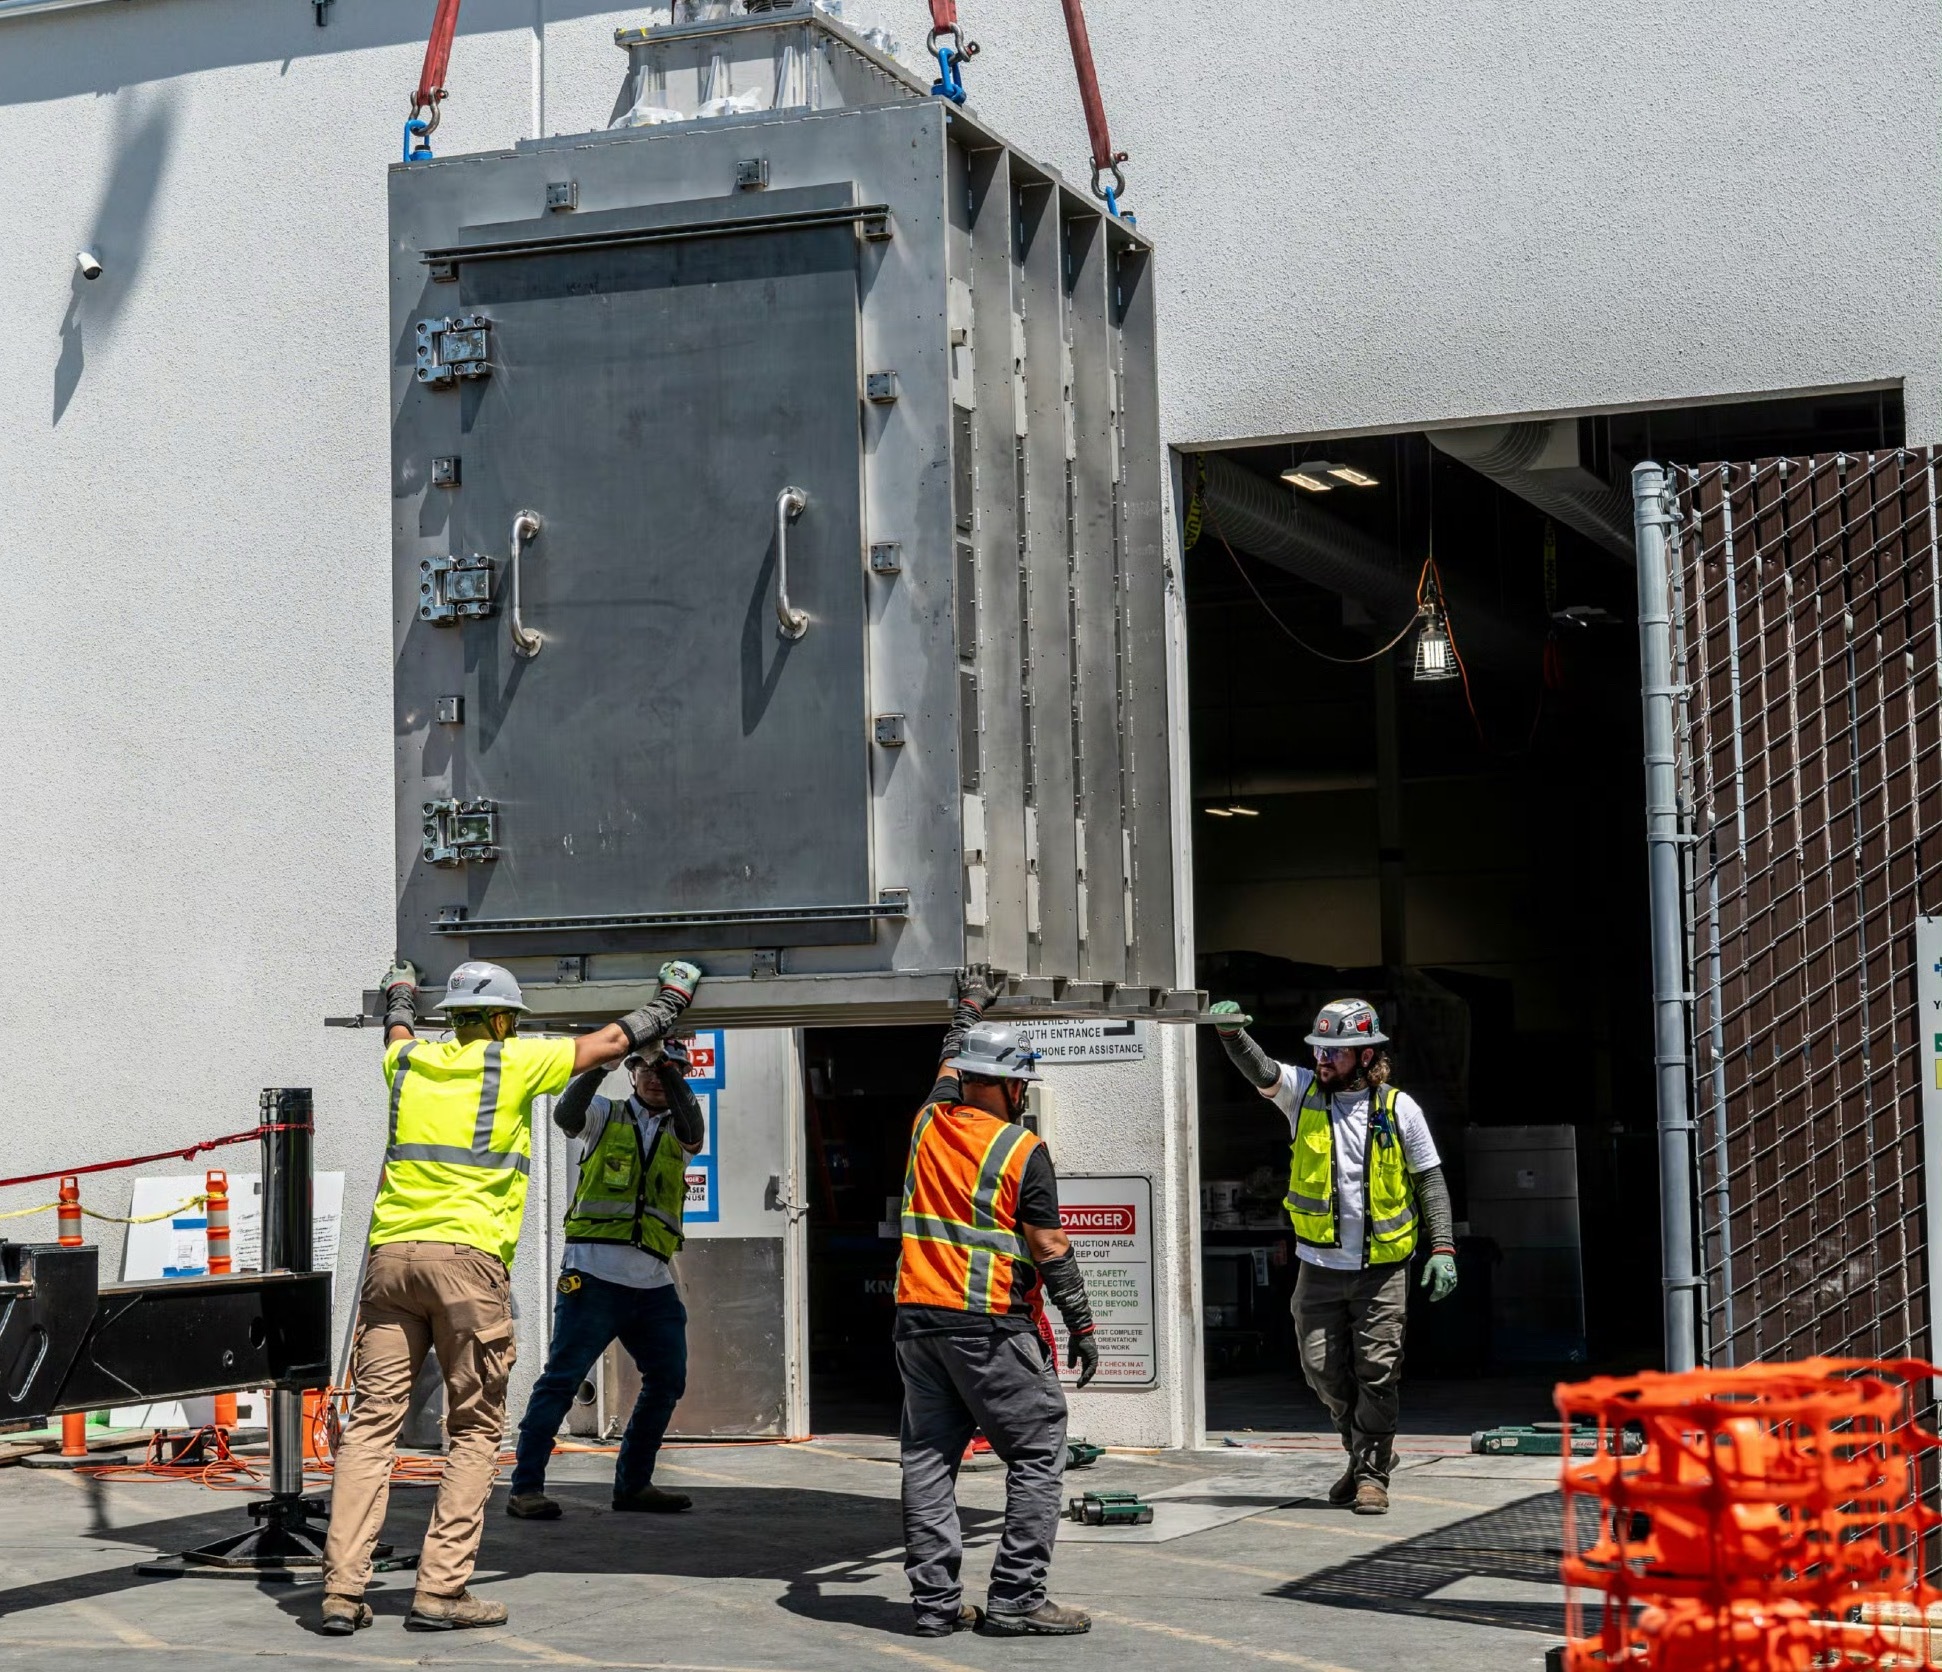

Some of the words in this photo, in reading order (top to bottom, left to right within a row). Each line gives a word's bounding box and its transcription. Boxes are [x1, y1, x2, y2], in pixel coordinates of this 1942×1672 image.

[1021, 1028, 1048, 1040] OUTH
[1050, 1027, 1101, 1039] ENTRANCE
[1036, 1046, 1066, 1057] PHONE
[1068, 1045, 1087, 1056] FOR
[1089, 1043, 1144, 1055] ASSISTANCE
[692, 1194, 705, 1202] USE
[1059, 1213, 1123, 1226] DANGER
[1111, 1239, 1135, 1248] AREA
[1075, 1250, 1092, 1258] EEP
[1093, 1250, 1111, 1258] OUT
[1096, 1269, 1128, 1278] SAFETY
[1087, 1279, 1136, 1288] REFLECTIVE
[1110, 1289, 1139, 1298] BOOTS
[1105, 1299, 1139, 1308] BEYOND
[1123, 1369, 1147, 1377] OFFICE
